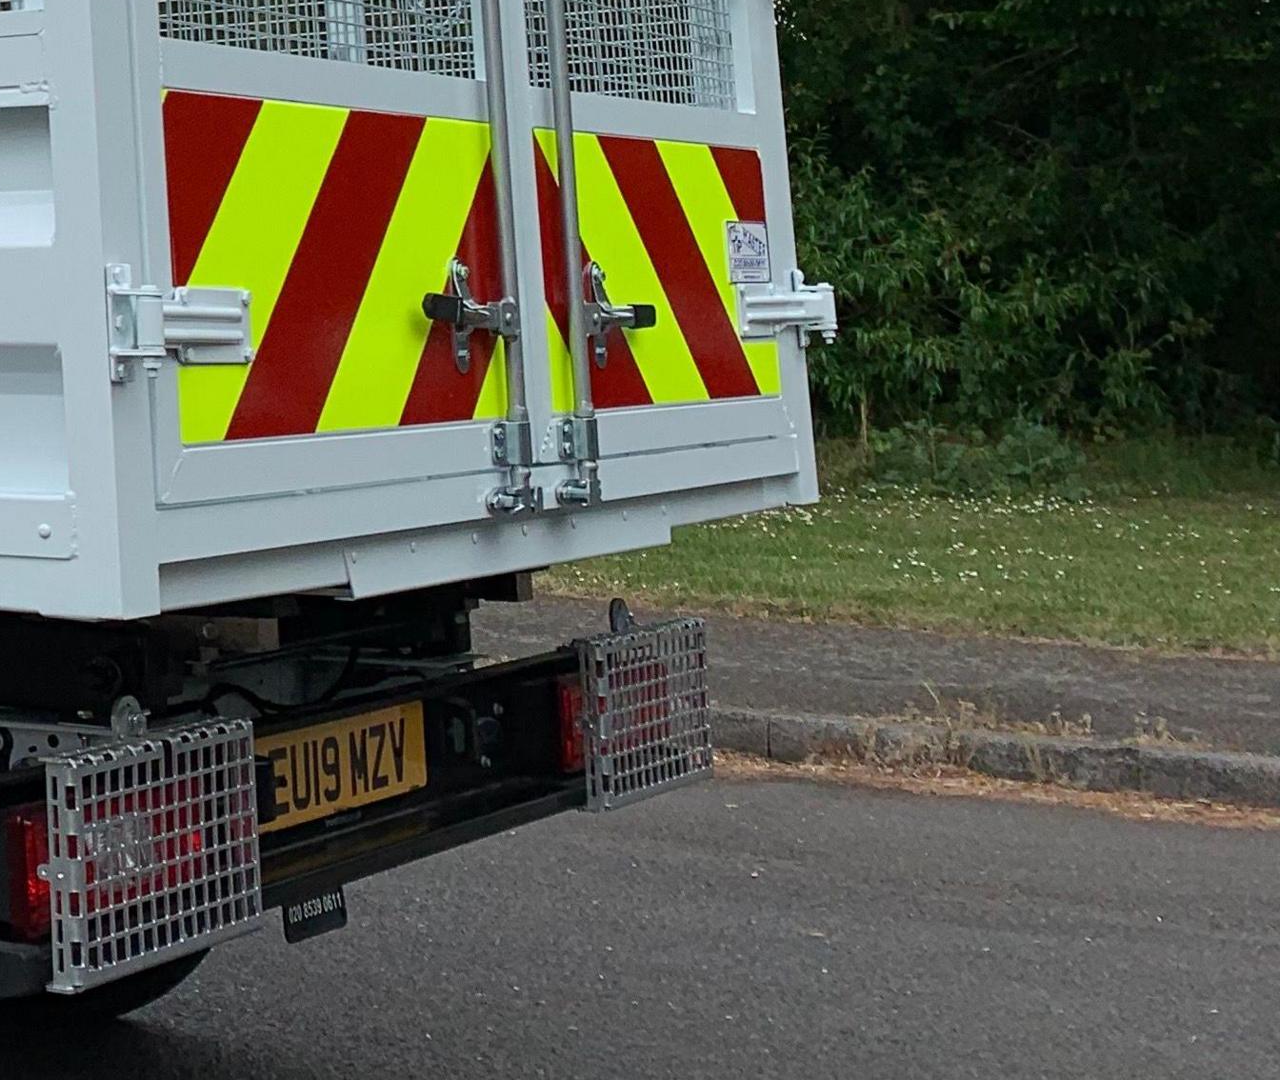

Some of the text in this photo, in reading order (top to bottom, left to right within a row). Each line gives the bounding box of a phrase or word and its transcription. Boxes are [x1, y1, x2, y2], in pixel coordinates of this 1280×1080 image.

[268, 718, 405, 816] EU19 MZV
[288, 904, 303, 924] 020
[322, 891, 342, 912] 0611
